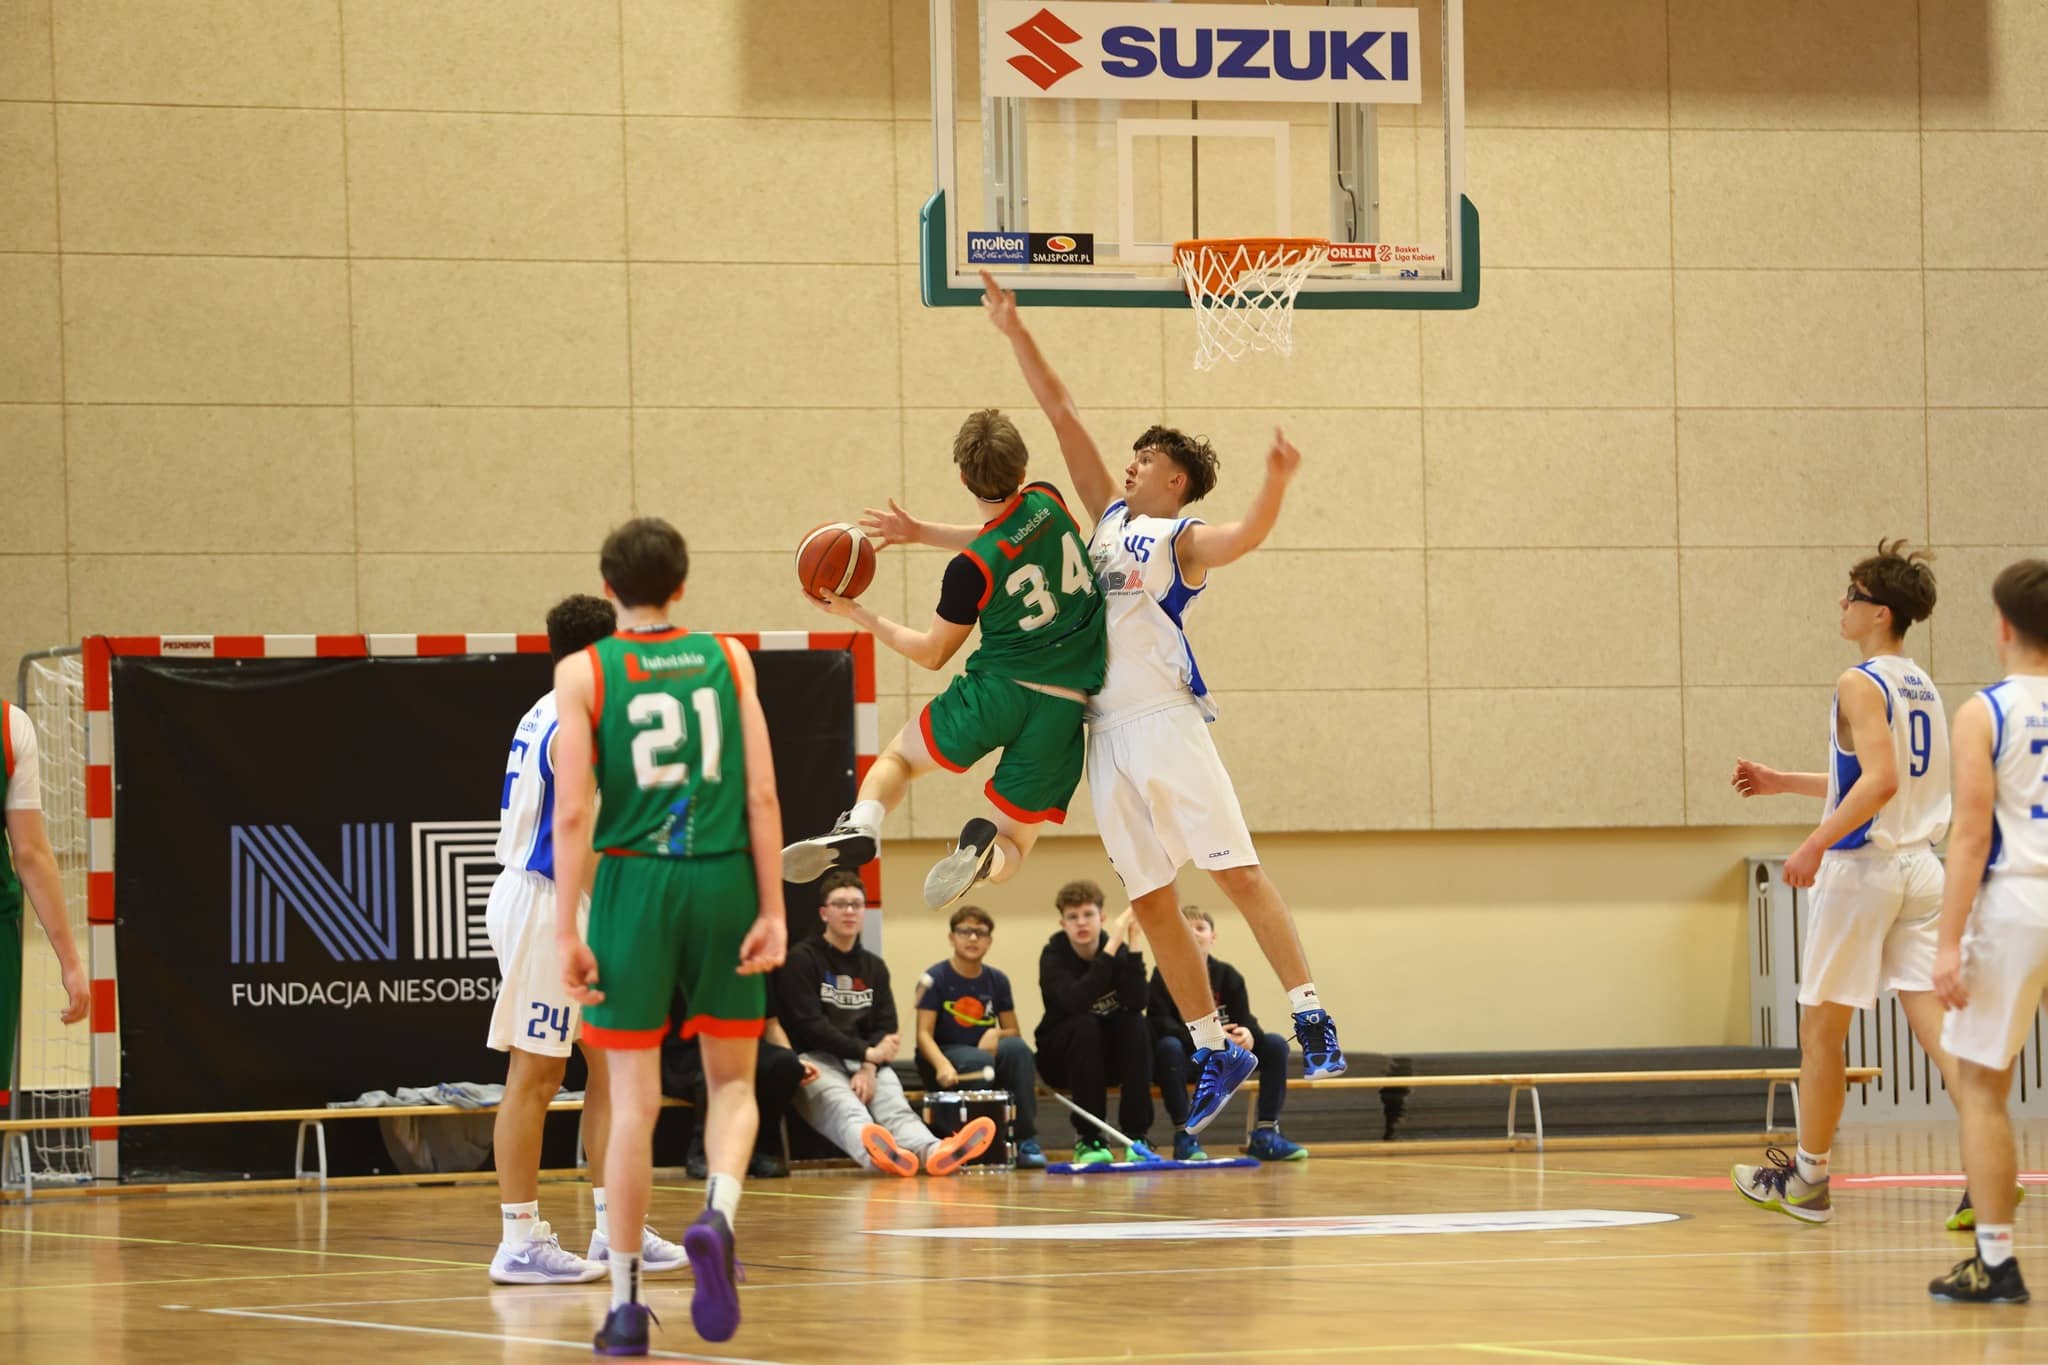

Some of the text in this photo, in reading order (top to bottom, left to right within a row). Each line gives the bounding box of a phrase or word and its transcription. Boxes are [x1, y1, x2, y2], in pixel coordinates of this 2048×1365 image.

[1101, 26, 1408, 81] SUZUKI
[972, 236, 1024, 251] molten
[1033, 253, 1090, 263] SMJSPORT.PL
[1331, 247, 1371, 259] ORLEN
[1395, 254, 1410, 262] Liga
[1010, 507, 1051, 544] lubelskie
[1124, 534, 1155, 563] 45
[1005, 531, 1096, 632] 34
[627, 687, 724, 791] 21
[1909, 709, 1931, 778] 9
[231, 980, 372, 1009] FUNDACJA
[527, 1001, 570, 1042] 24
